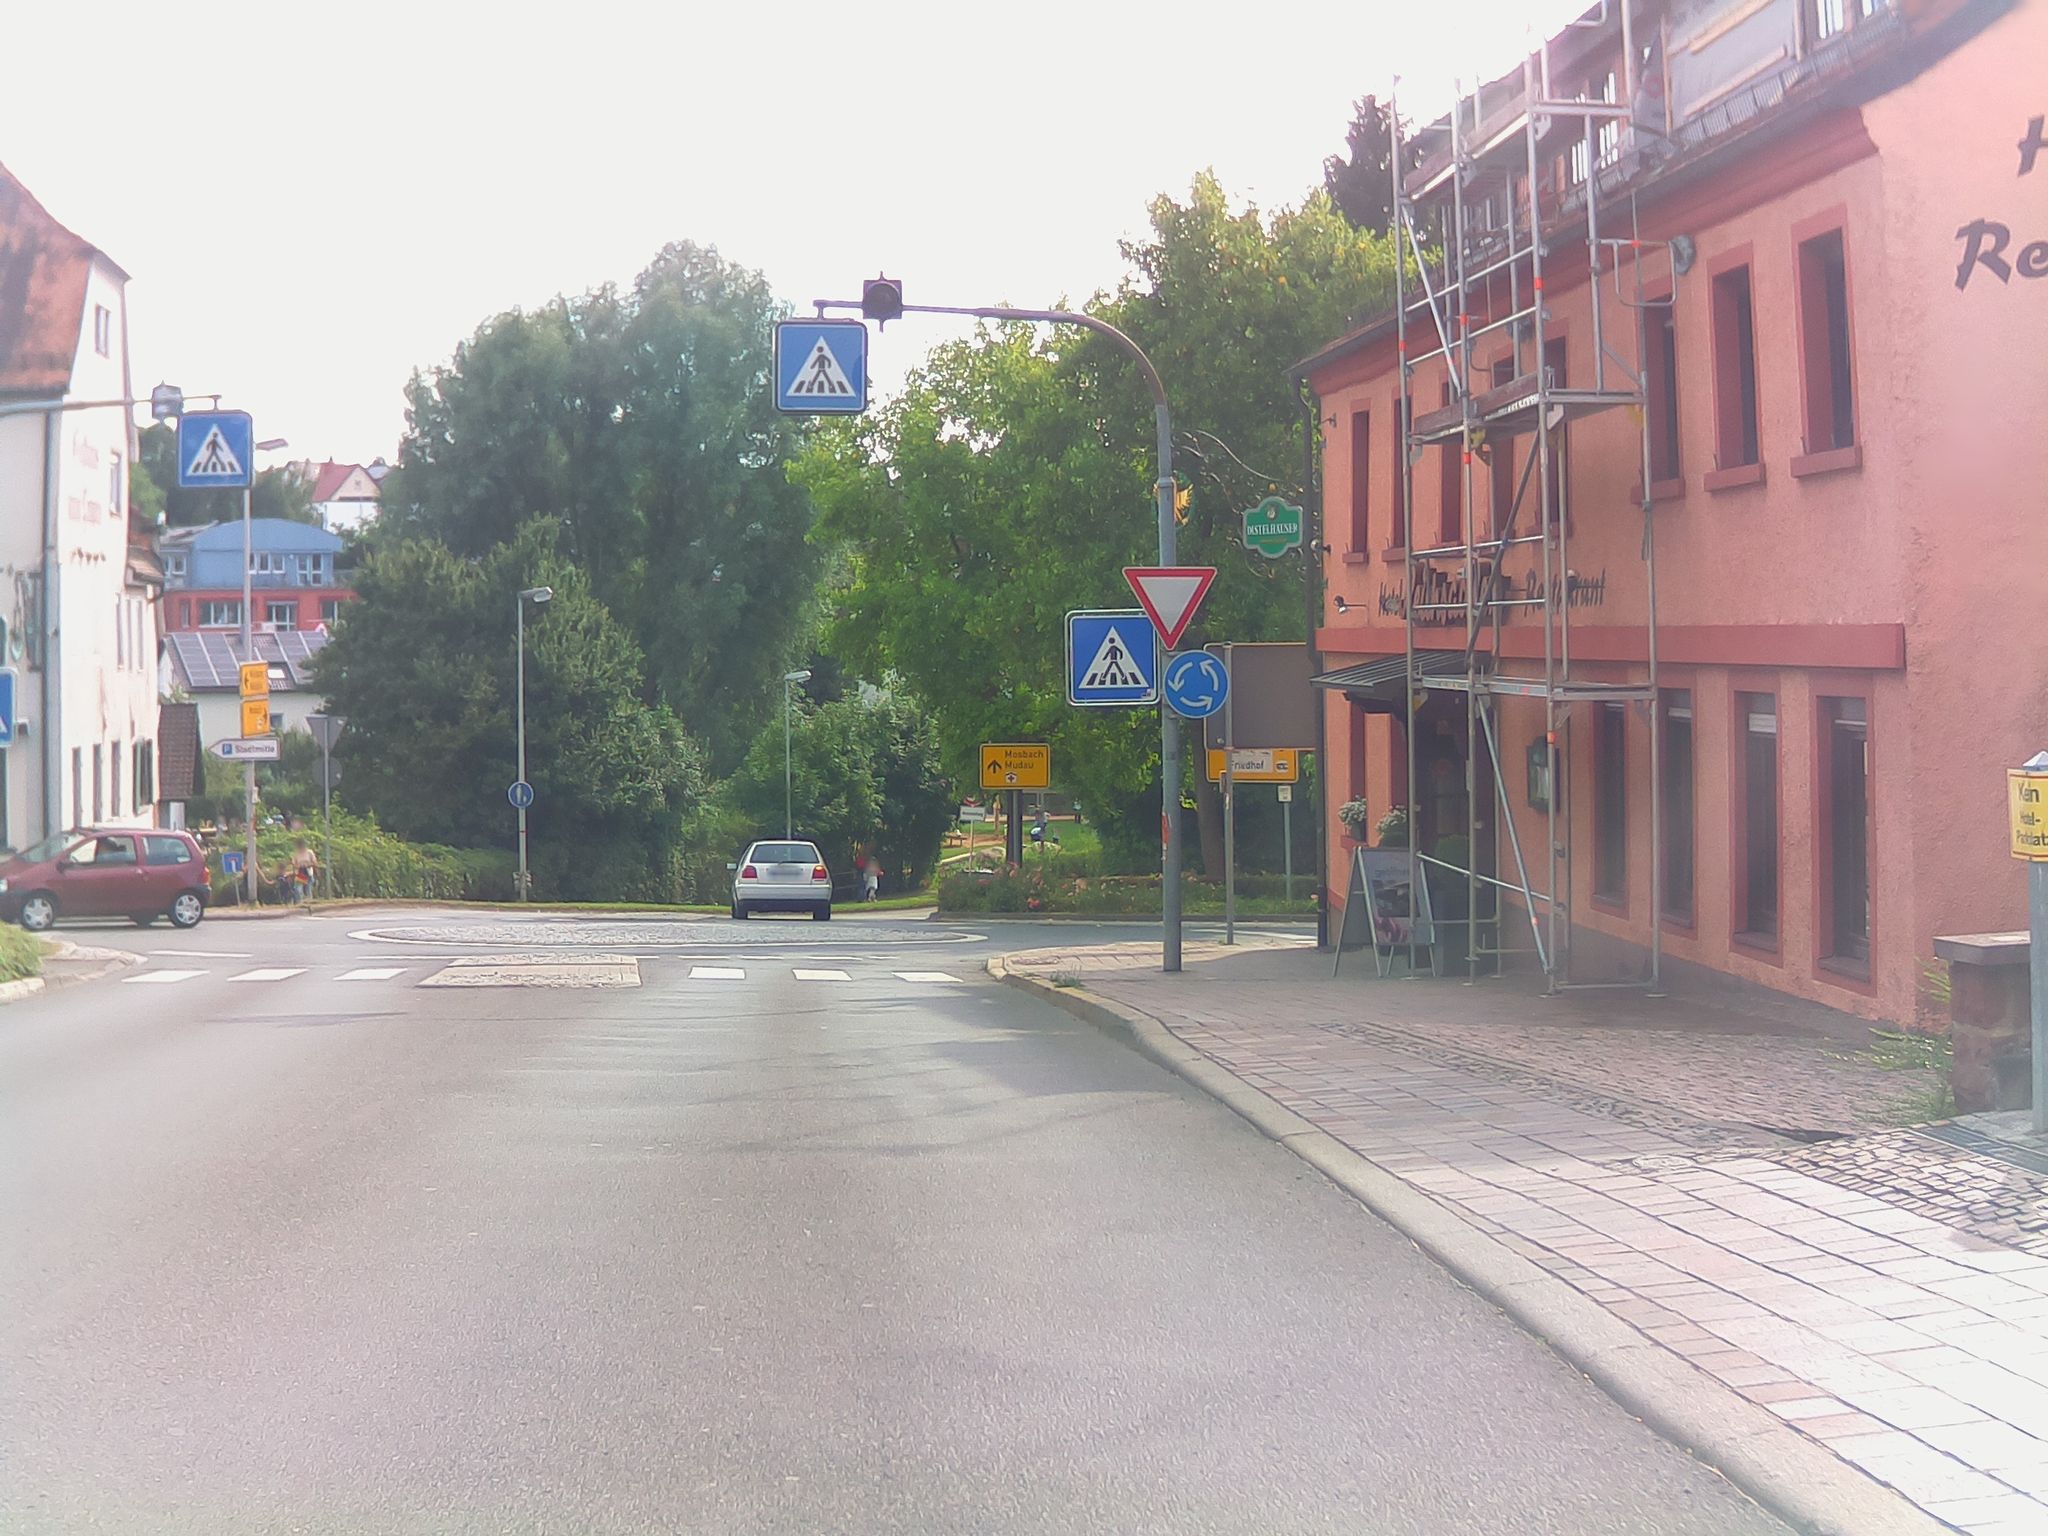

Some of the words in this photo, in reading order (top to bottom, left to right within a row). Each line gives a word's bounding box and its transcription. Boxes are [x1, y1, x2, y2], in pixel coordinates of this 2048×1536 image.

[1004, 749, 1044, 759] Mosbach
[1004, 760, 1034, 769] Mudau
[2016, 830, 2048, 846] Parkplat
